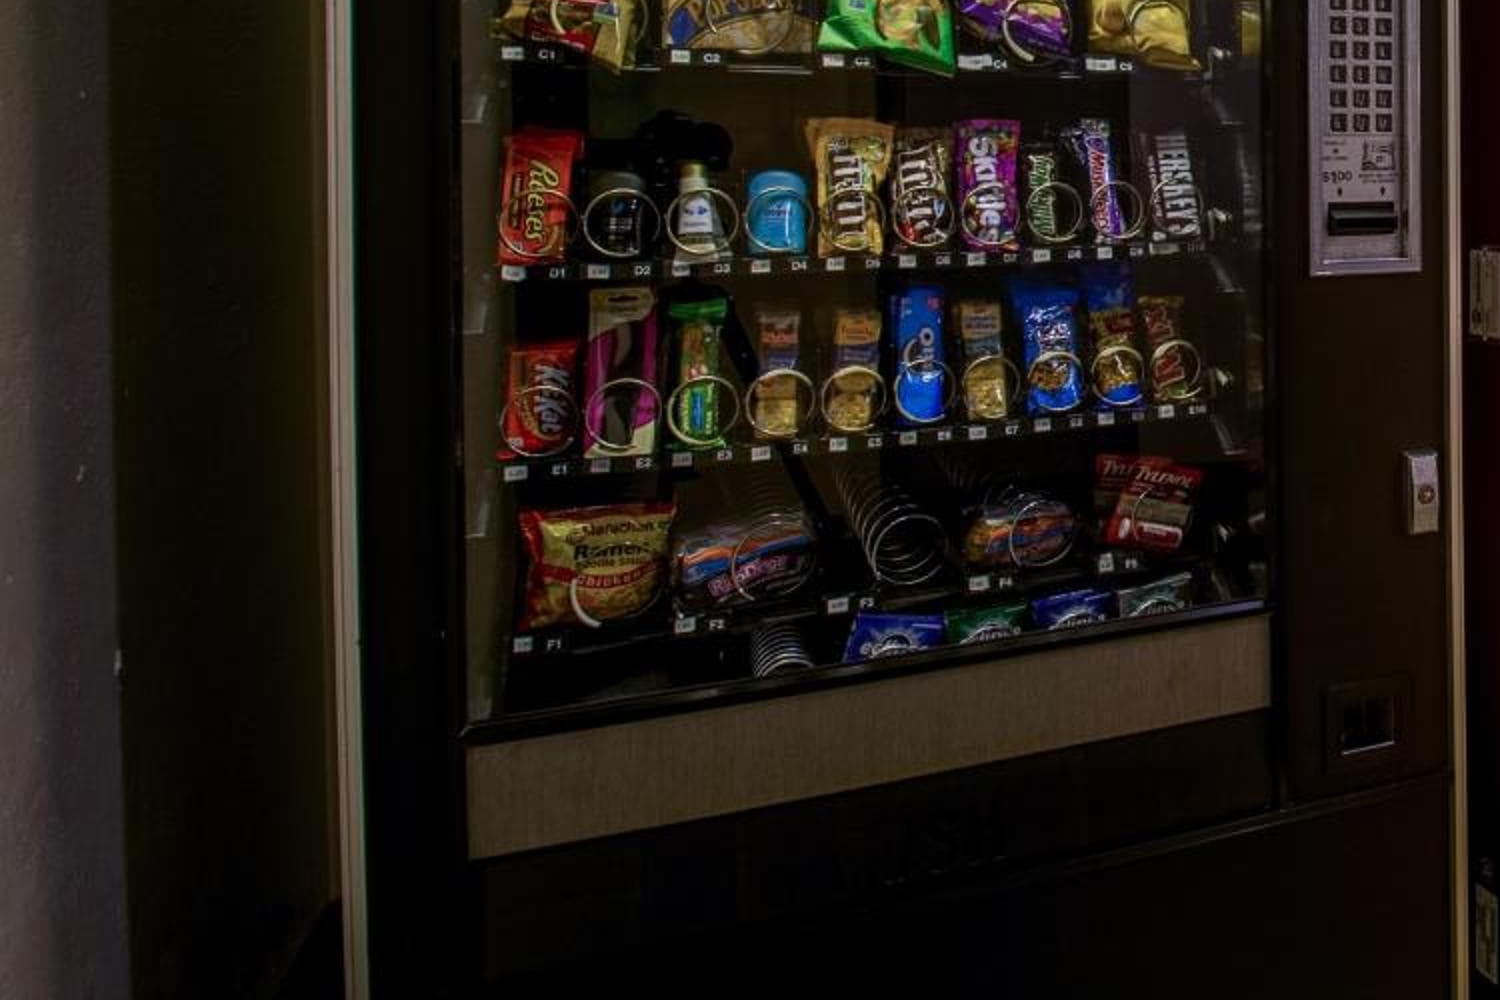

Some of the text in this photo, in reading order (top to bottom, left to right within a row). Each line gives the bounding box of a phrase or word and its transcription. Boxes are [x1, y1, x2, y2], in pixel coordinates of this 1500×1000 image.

[537, 50, 556, 61] C1
[703, 53, 721, 64] C2
[992, 59, 1008, 71] C4
[970, 136, 1006, 243] Skittles
[634, 264, 652, 276] D2
[714, 262, 732, 273] D3
[791, 260, 808, 271] D4
[549, 267, 566, 279] D1
[636, 457, 653, 470] E2
[1135, 463, 1194, 489] TYLENOL
[546, 639, 562, 651] F1
